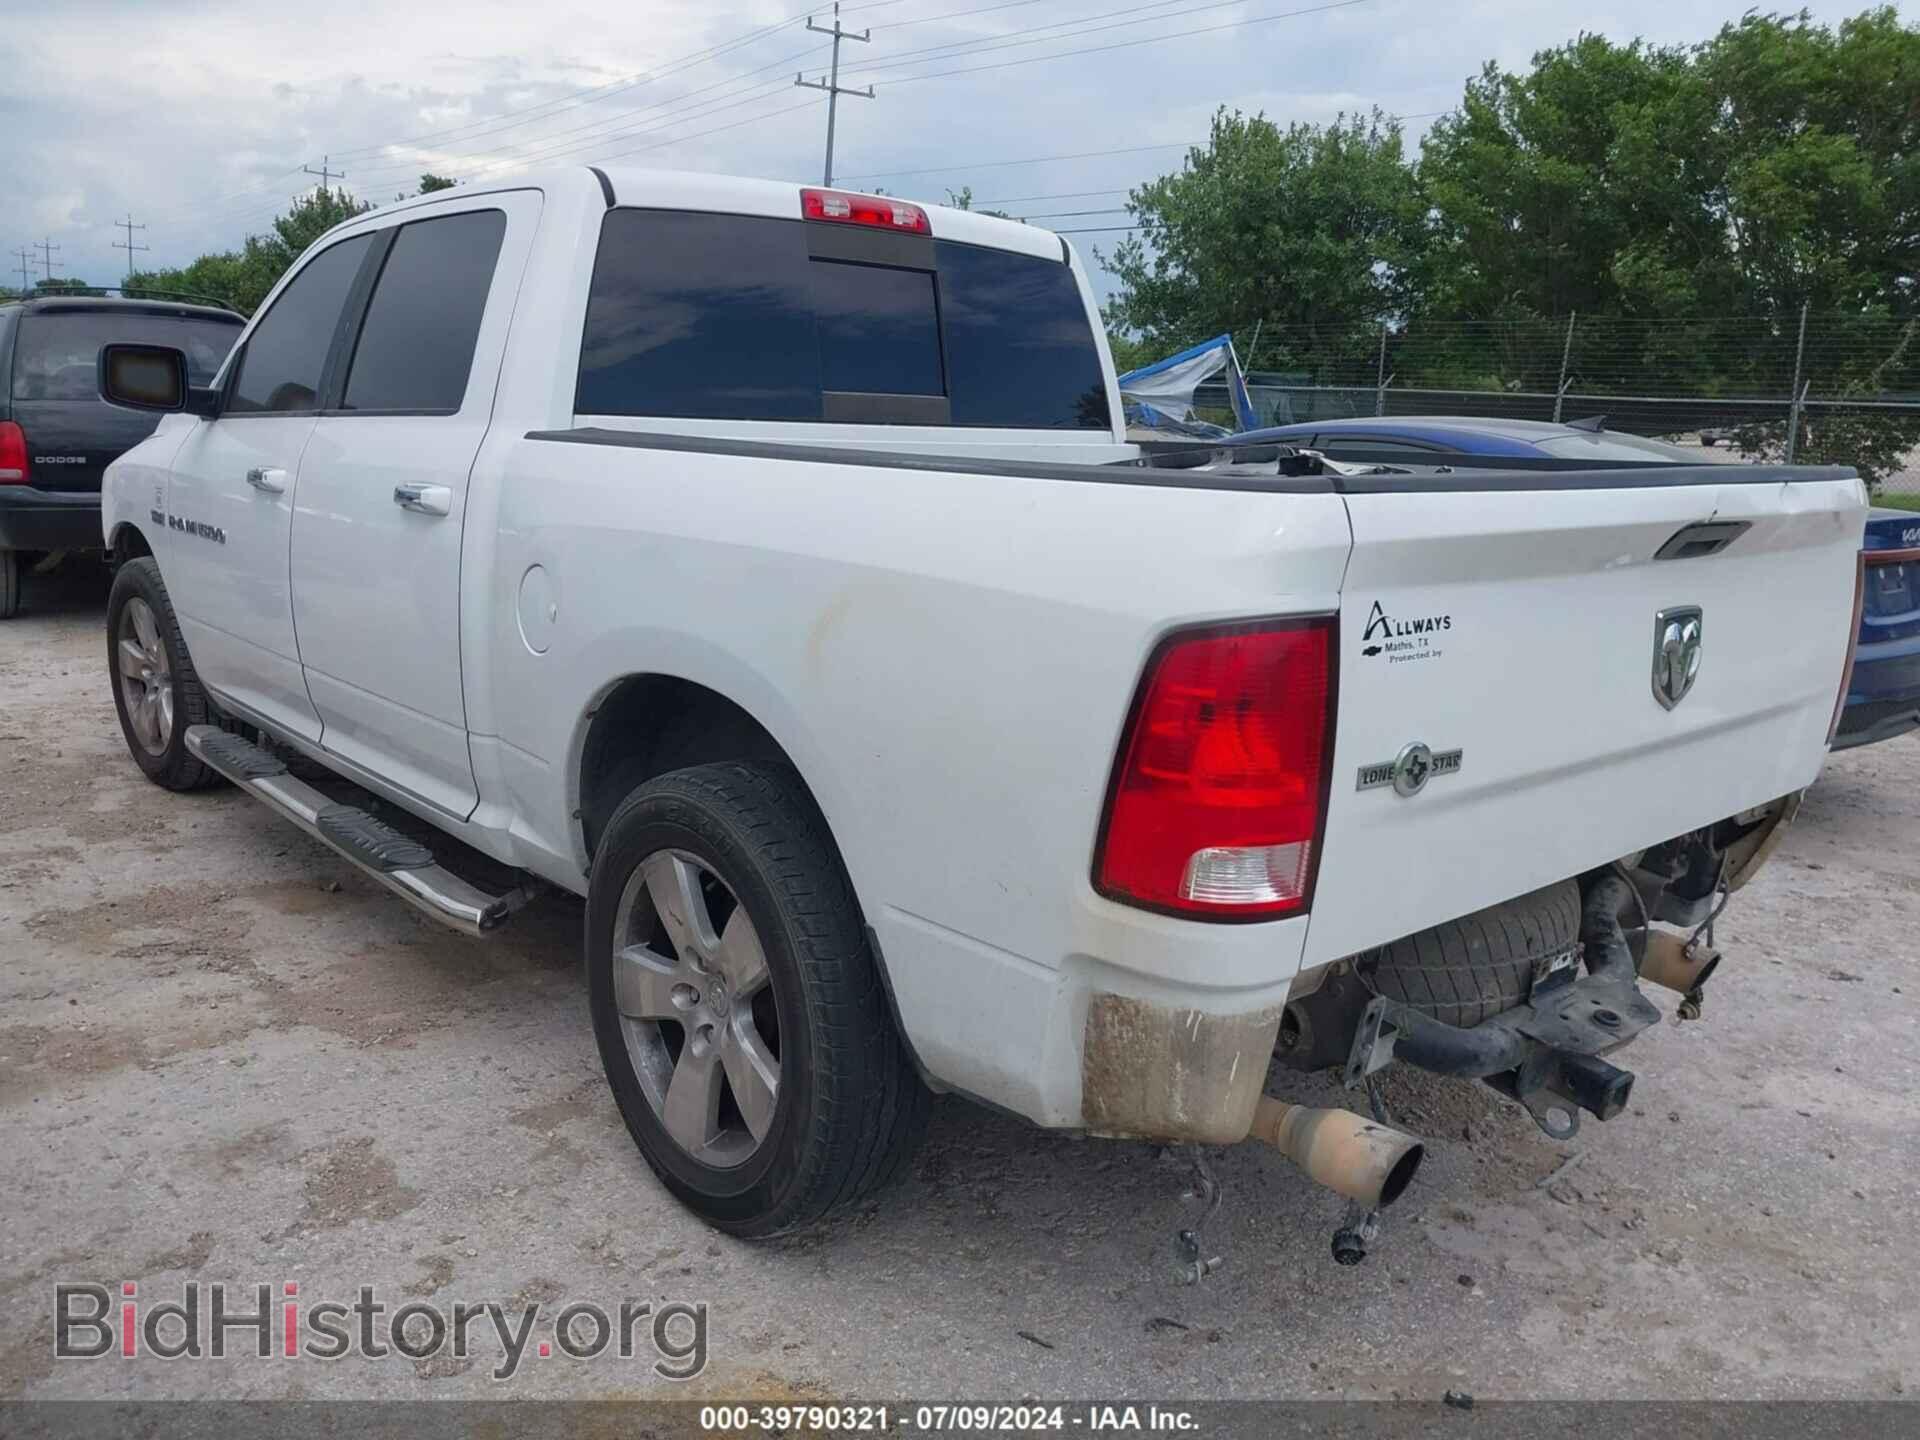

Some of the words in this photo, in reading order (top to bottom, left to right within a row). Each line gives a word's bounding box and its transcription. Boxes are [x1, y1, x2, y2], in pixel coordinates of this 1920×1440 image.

[35, 456, 87, 464] DODGE
[1362, 600, 1451, 641] ALLWAYS
[1418, 637, 1429, 647] TX
[1389, 650, 1430, 663] Protected
[1362, 766, 1395, 785] LONE
[1432, 755, 1460, 772] STAR
